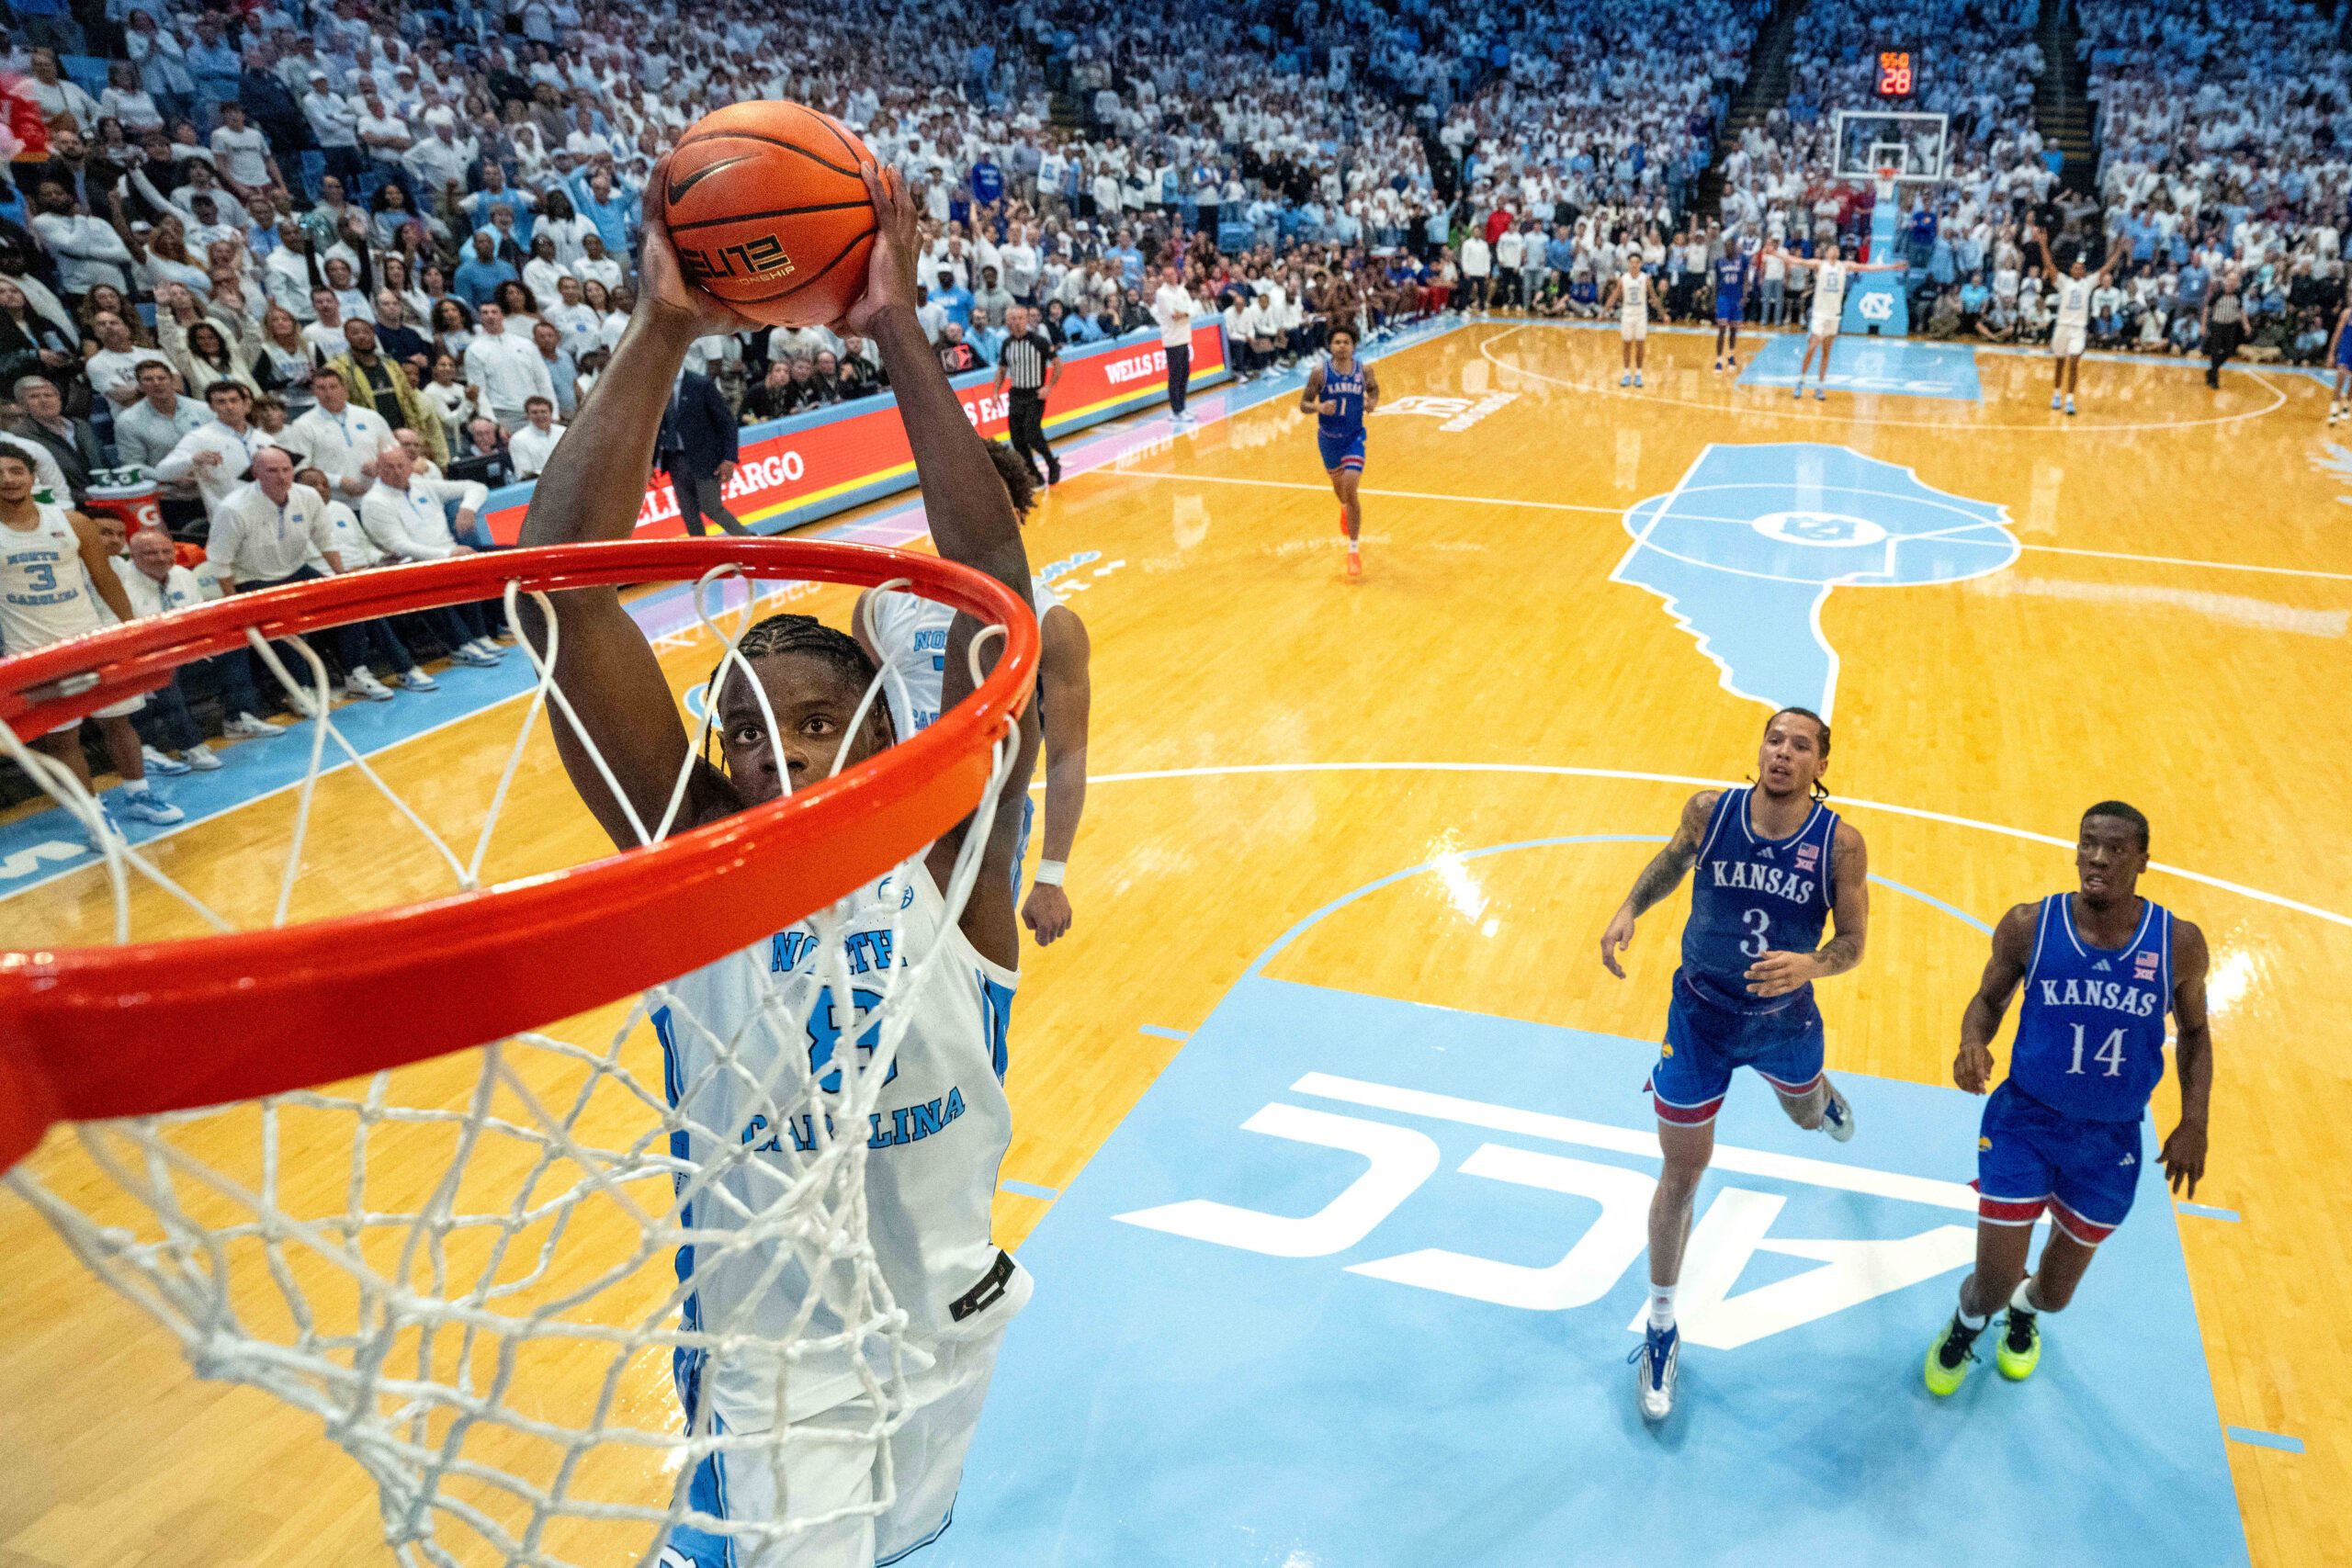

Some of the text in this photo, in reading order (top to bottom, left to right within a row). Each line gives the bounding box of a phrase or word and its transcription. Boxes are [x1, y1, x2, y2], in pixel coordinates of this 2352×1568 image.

[1881, 68, 1911, 95] 28
[1104, 354, 1153, 384] WELLS
[1340, 397, 1347, 416] 1
[721, 451, 805, 502] ARGO
[138, 505, 161, 526] G
[24, 564, 57, 591] 3
[1712, 861, 1815, 905] KANSAS
[1739, 908, 1770, 958] 3
[2040, 979, 2157, 1017] KANSAS
[2065, 1022, 2129, 1077] 14
[741, 1086, 966, 1152] CARLINA
[1109, 1101, 1979, 1350] ACC
